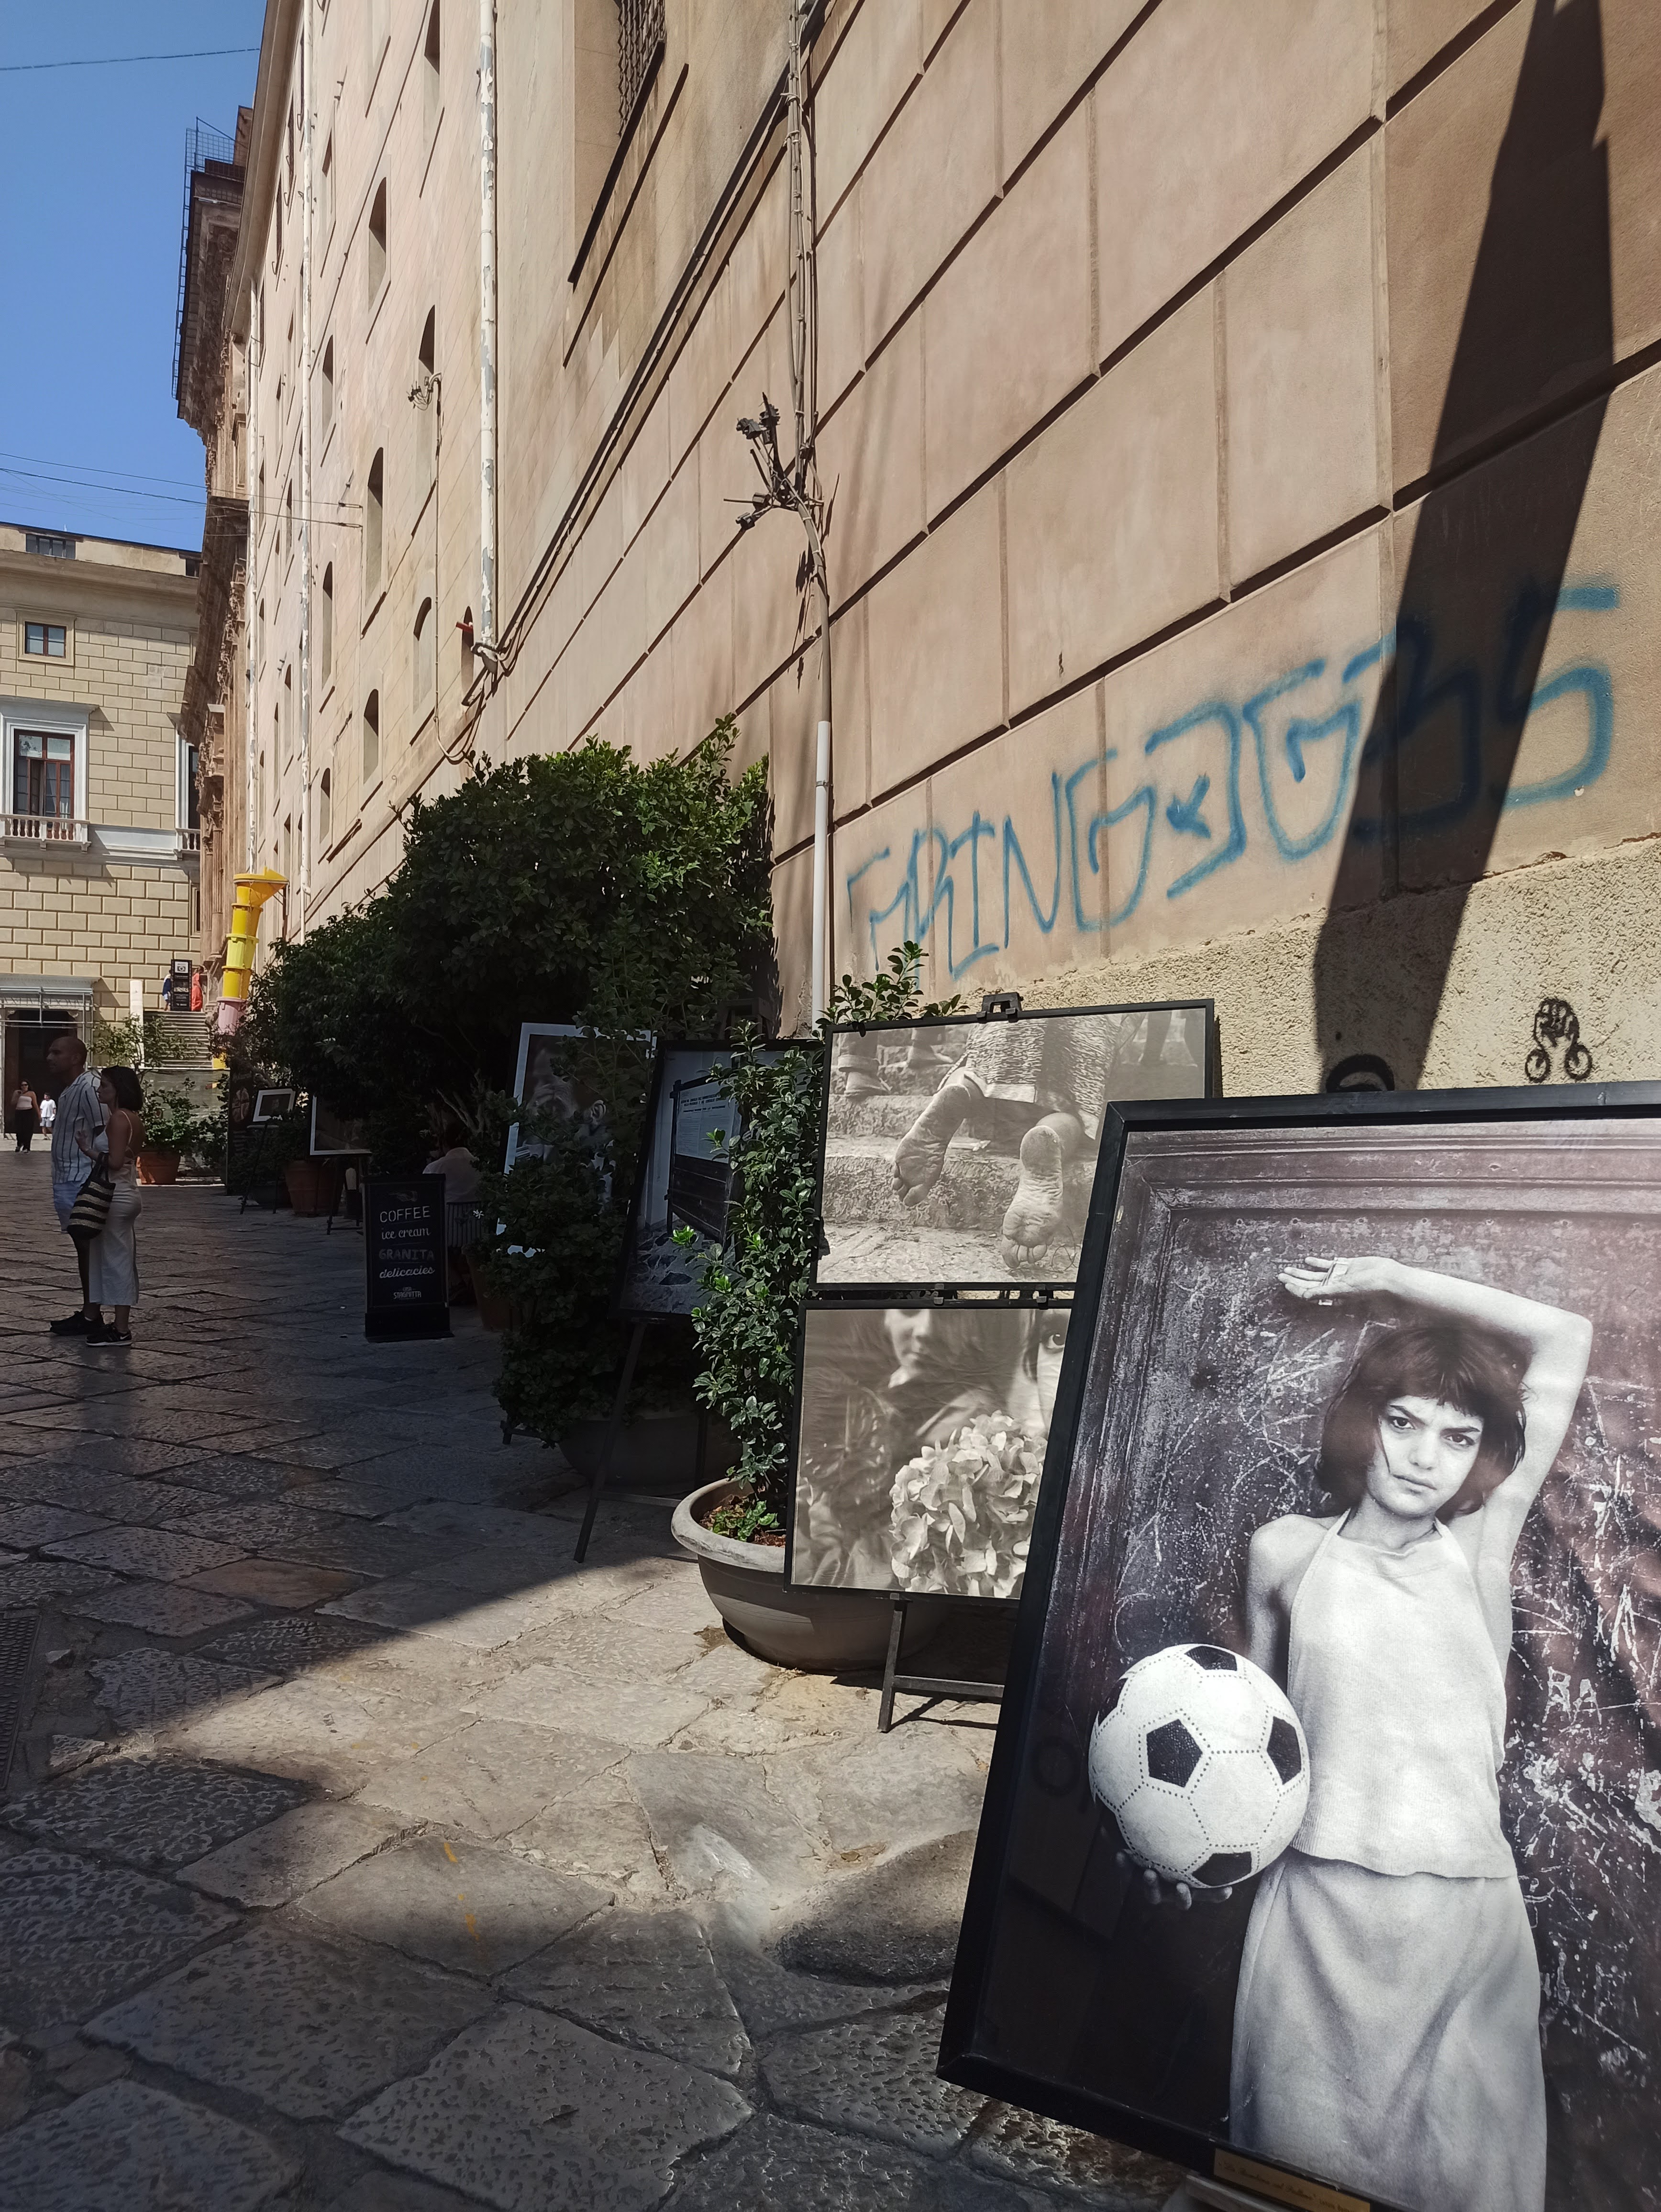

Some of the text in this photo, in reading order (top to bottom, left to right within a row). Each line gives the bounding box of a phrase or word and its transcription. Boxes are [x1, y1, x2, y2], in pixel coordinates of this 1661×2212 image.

[380, 1206, 431, 1223] COFFEE
[381, 1227, 431, 1240] ice cream
[378, 1248, 435, 1261] GRANITA
[379, 1265, 435, 1279] delicacies
